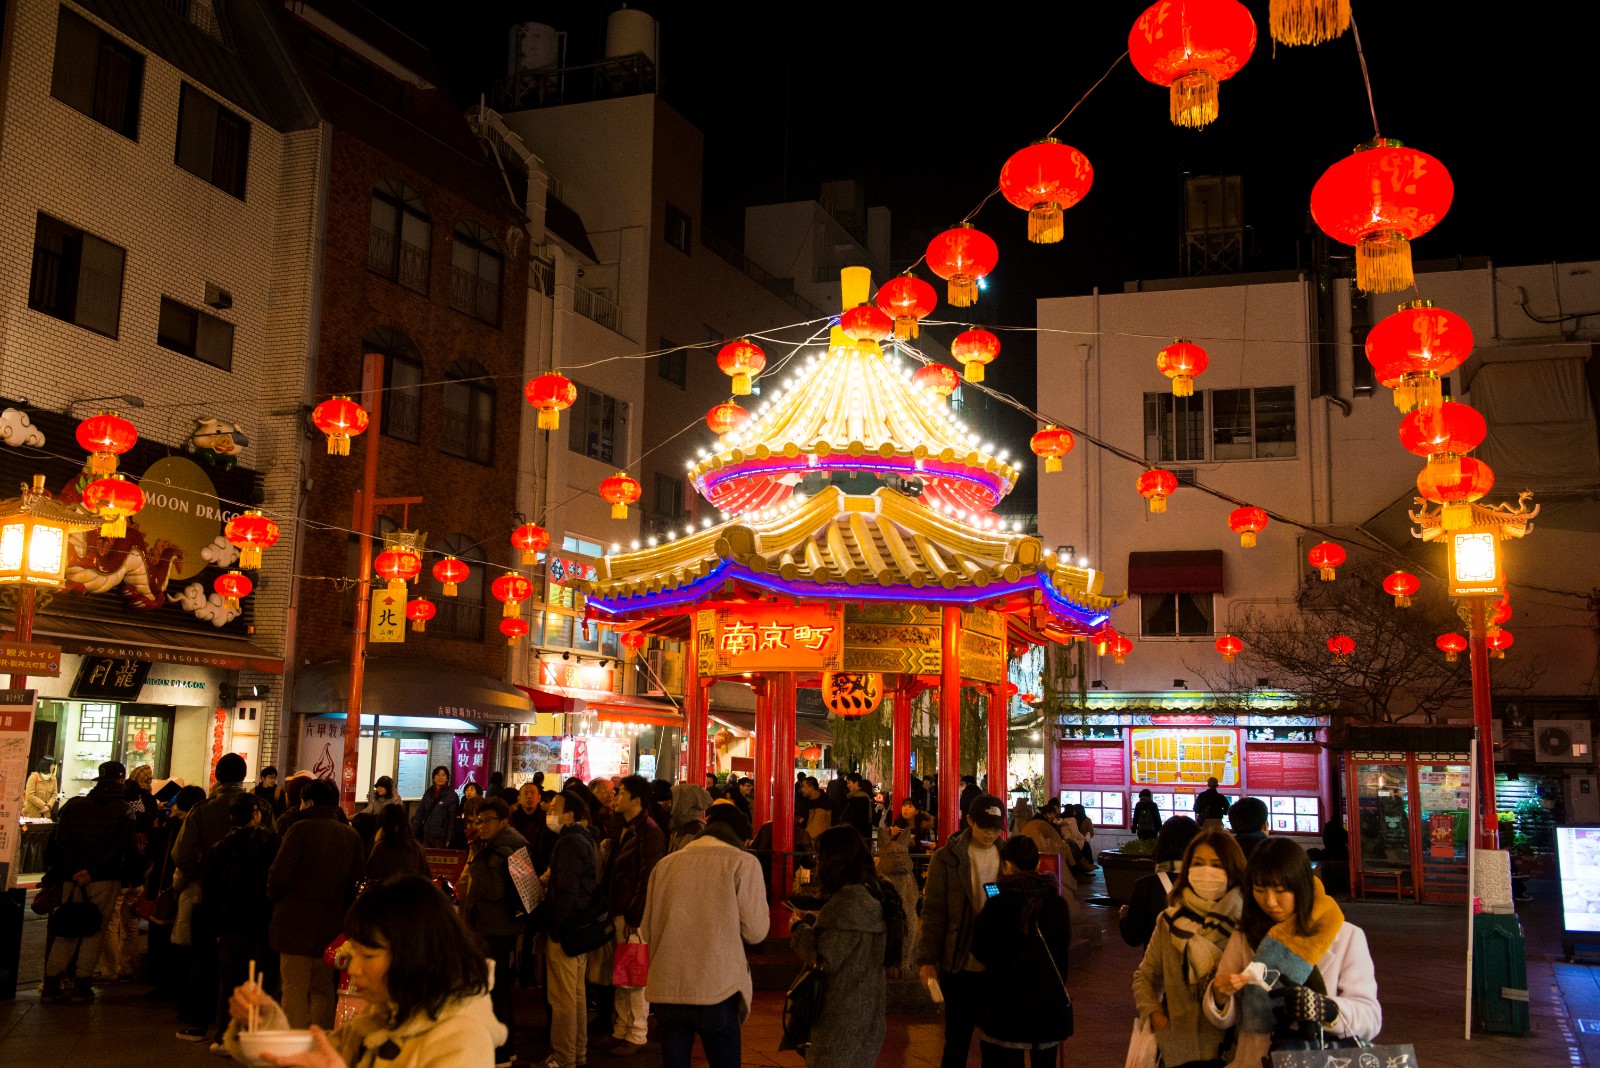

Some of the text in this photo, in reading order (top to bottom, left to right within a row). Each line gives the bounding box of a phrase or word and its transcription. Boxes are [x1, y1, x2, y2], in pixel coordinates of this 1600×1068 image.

[145, 491, 189, 514] MOON
[378, 608, 398, 627] 北
[721, 620, 836, 655] 南京町
[6, 648, 55, 659] 観光トイレ
[119, 649, 199, 663] MOON DRAGON
[0, 659, 47, 670] R・阪神元町駅
[171, 679, 206, 689] DRAGON
[458, 738, 485, 752] 六甲
